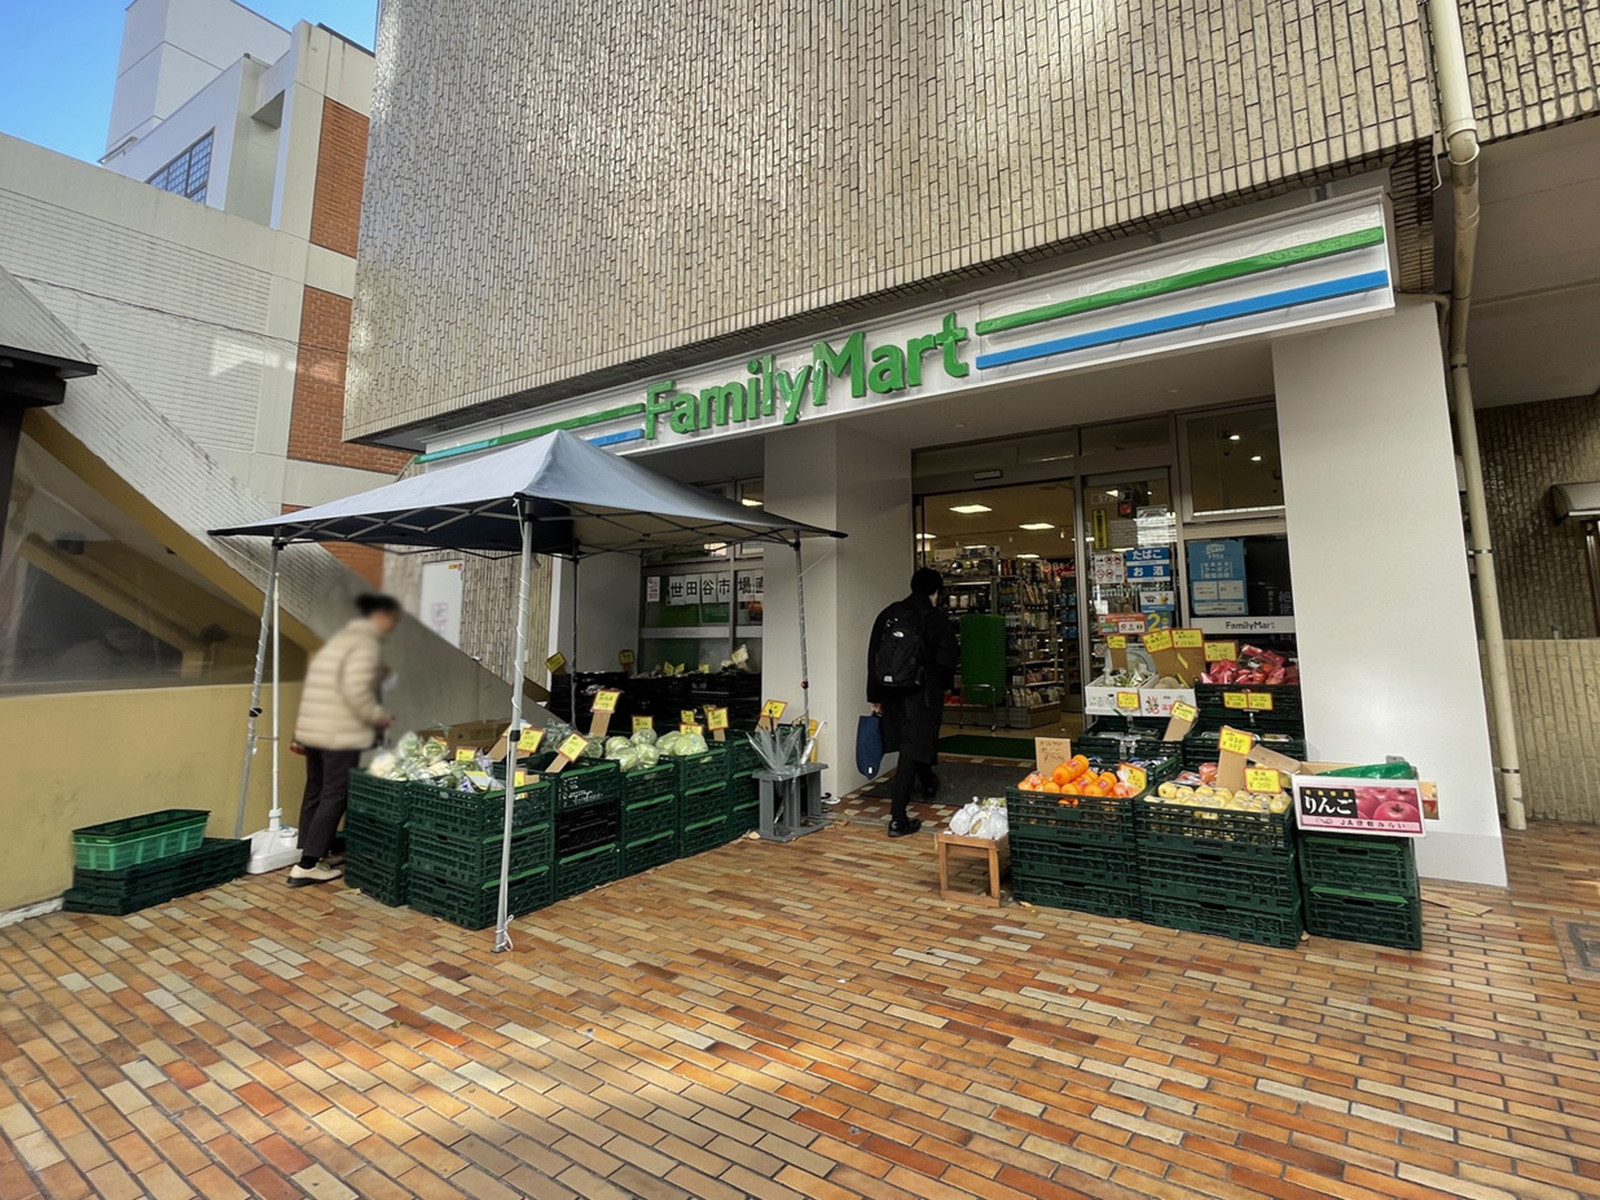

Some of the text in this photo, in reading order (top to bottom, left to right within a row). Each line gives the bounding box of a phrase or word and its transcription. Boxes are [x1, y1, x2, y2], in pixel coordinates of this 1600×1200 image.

[645, 311, 970, 440] FamilyMart
[1132, 549, 1162, 561] たばこ
[1133, 565, 1164, 577] お酒
[1225, 621, 1275, 631] FamilyMart
[1304, 795, 1354, 814] りんご
